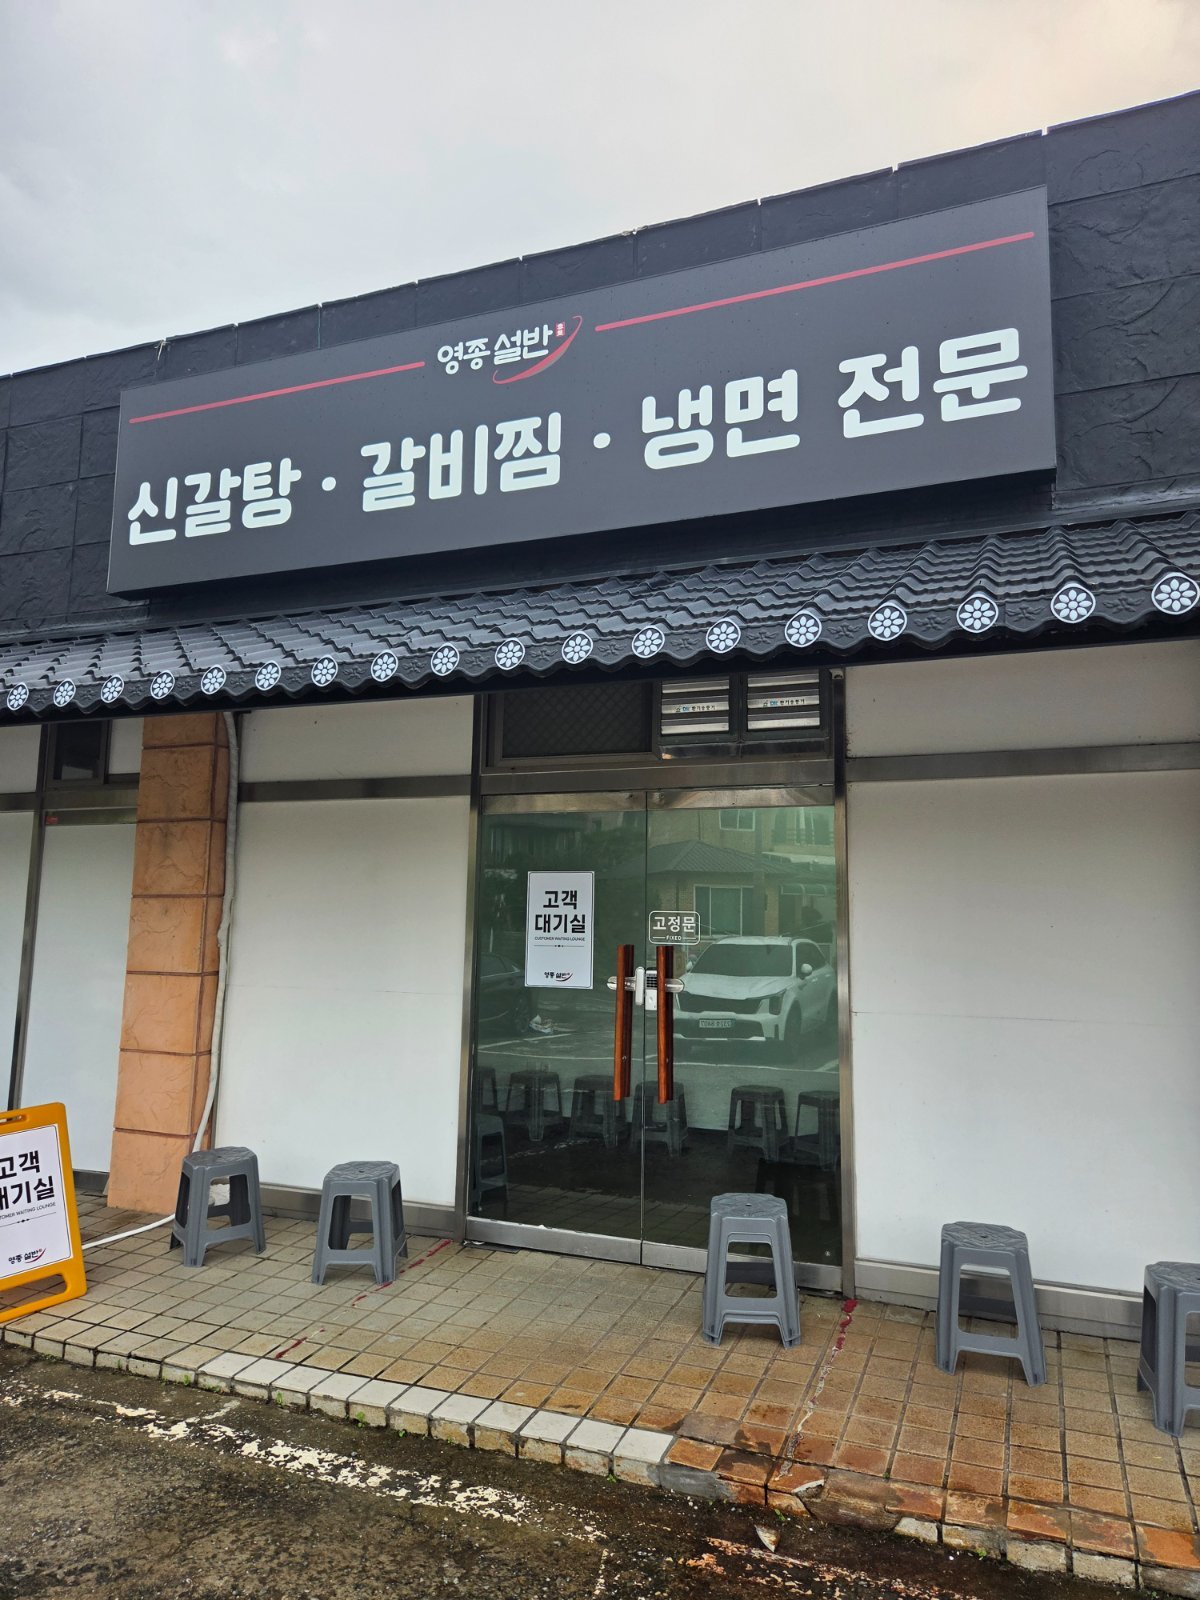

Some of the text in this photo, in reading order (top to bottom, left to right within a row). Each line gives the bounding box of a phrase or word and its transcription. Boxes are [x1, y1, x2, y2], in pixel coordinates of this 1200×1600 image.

[437, 338, 490, 375] 영종
[493, 324, 554, 366] 설반
[127, 327, 1028, 546] 신갈탕 갈비찜 냉면 전문
[543, 890, 578, 910] 고객
[534, 913, 586, 934] 대기실
[652, 916, 696, 933] 고정문
[0, 1150, 40, 1180] 고객
[16, 1207, 36, 1215] WAITING
[37, 1202, 56, 1210] LOUNGE
[8, 1250, 39, 1265] 영종 설반
